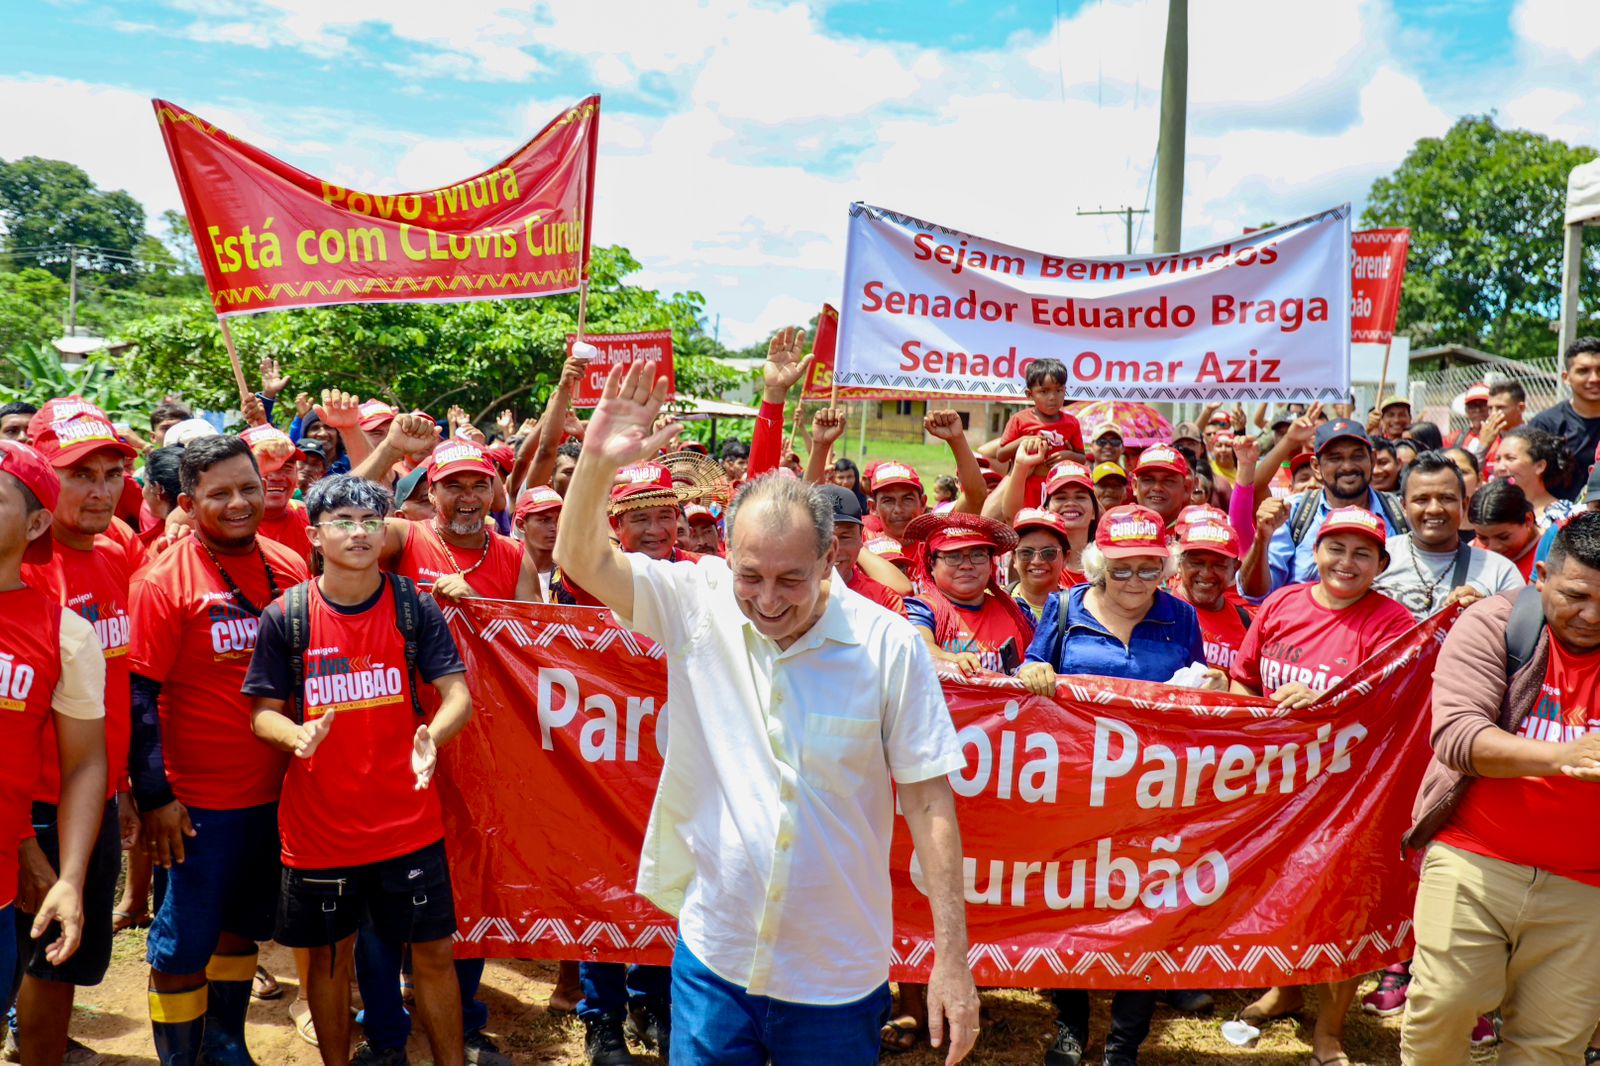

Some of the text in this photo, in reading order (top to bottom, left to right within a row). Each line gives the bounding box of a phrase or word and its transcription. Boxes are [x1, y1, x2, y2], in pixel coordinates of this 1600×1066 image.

[321, 167, 520, 220] Povo Mura
[207, 216, 283, 273] Está
[296, 226, 388, 265] com
[913, 233, 1279, 281] Sejam Bem-vindos
[861, 280, 1330, 333] Senador Eduardo Braga
[632, 343, 663, 363] Parente
[1072, 351, 1184, 384] Omar
[1194, 349, 1282, 384] Aziz
[1110, 518, 1158, 538] CURUBÃO
[304, 662, 403, 707] CURUBÃO
